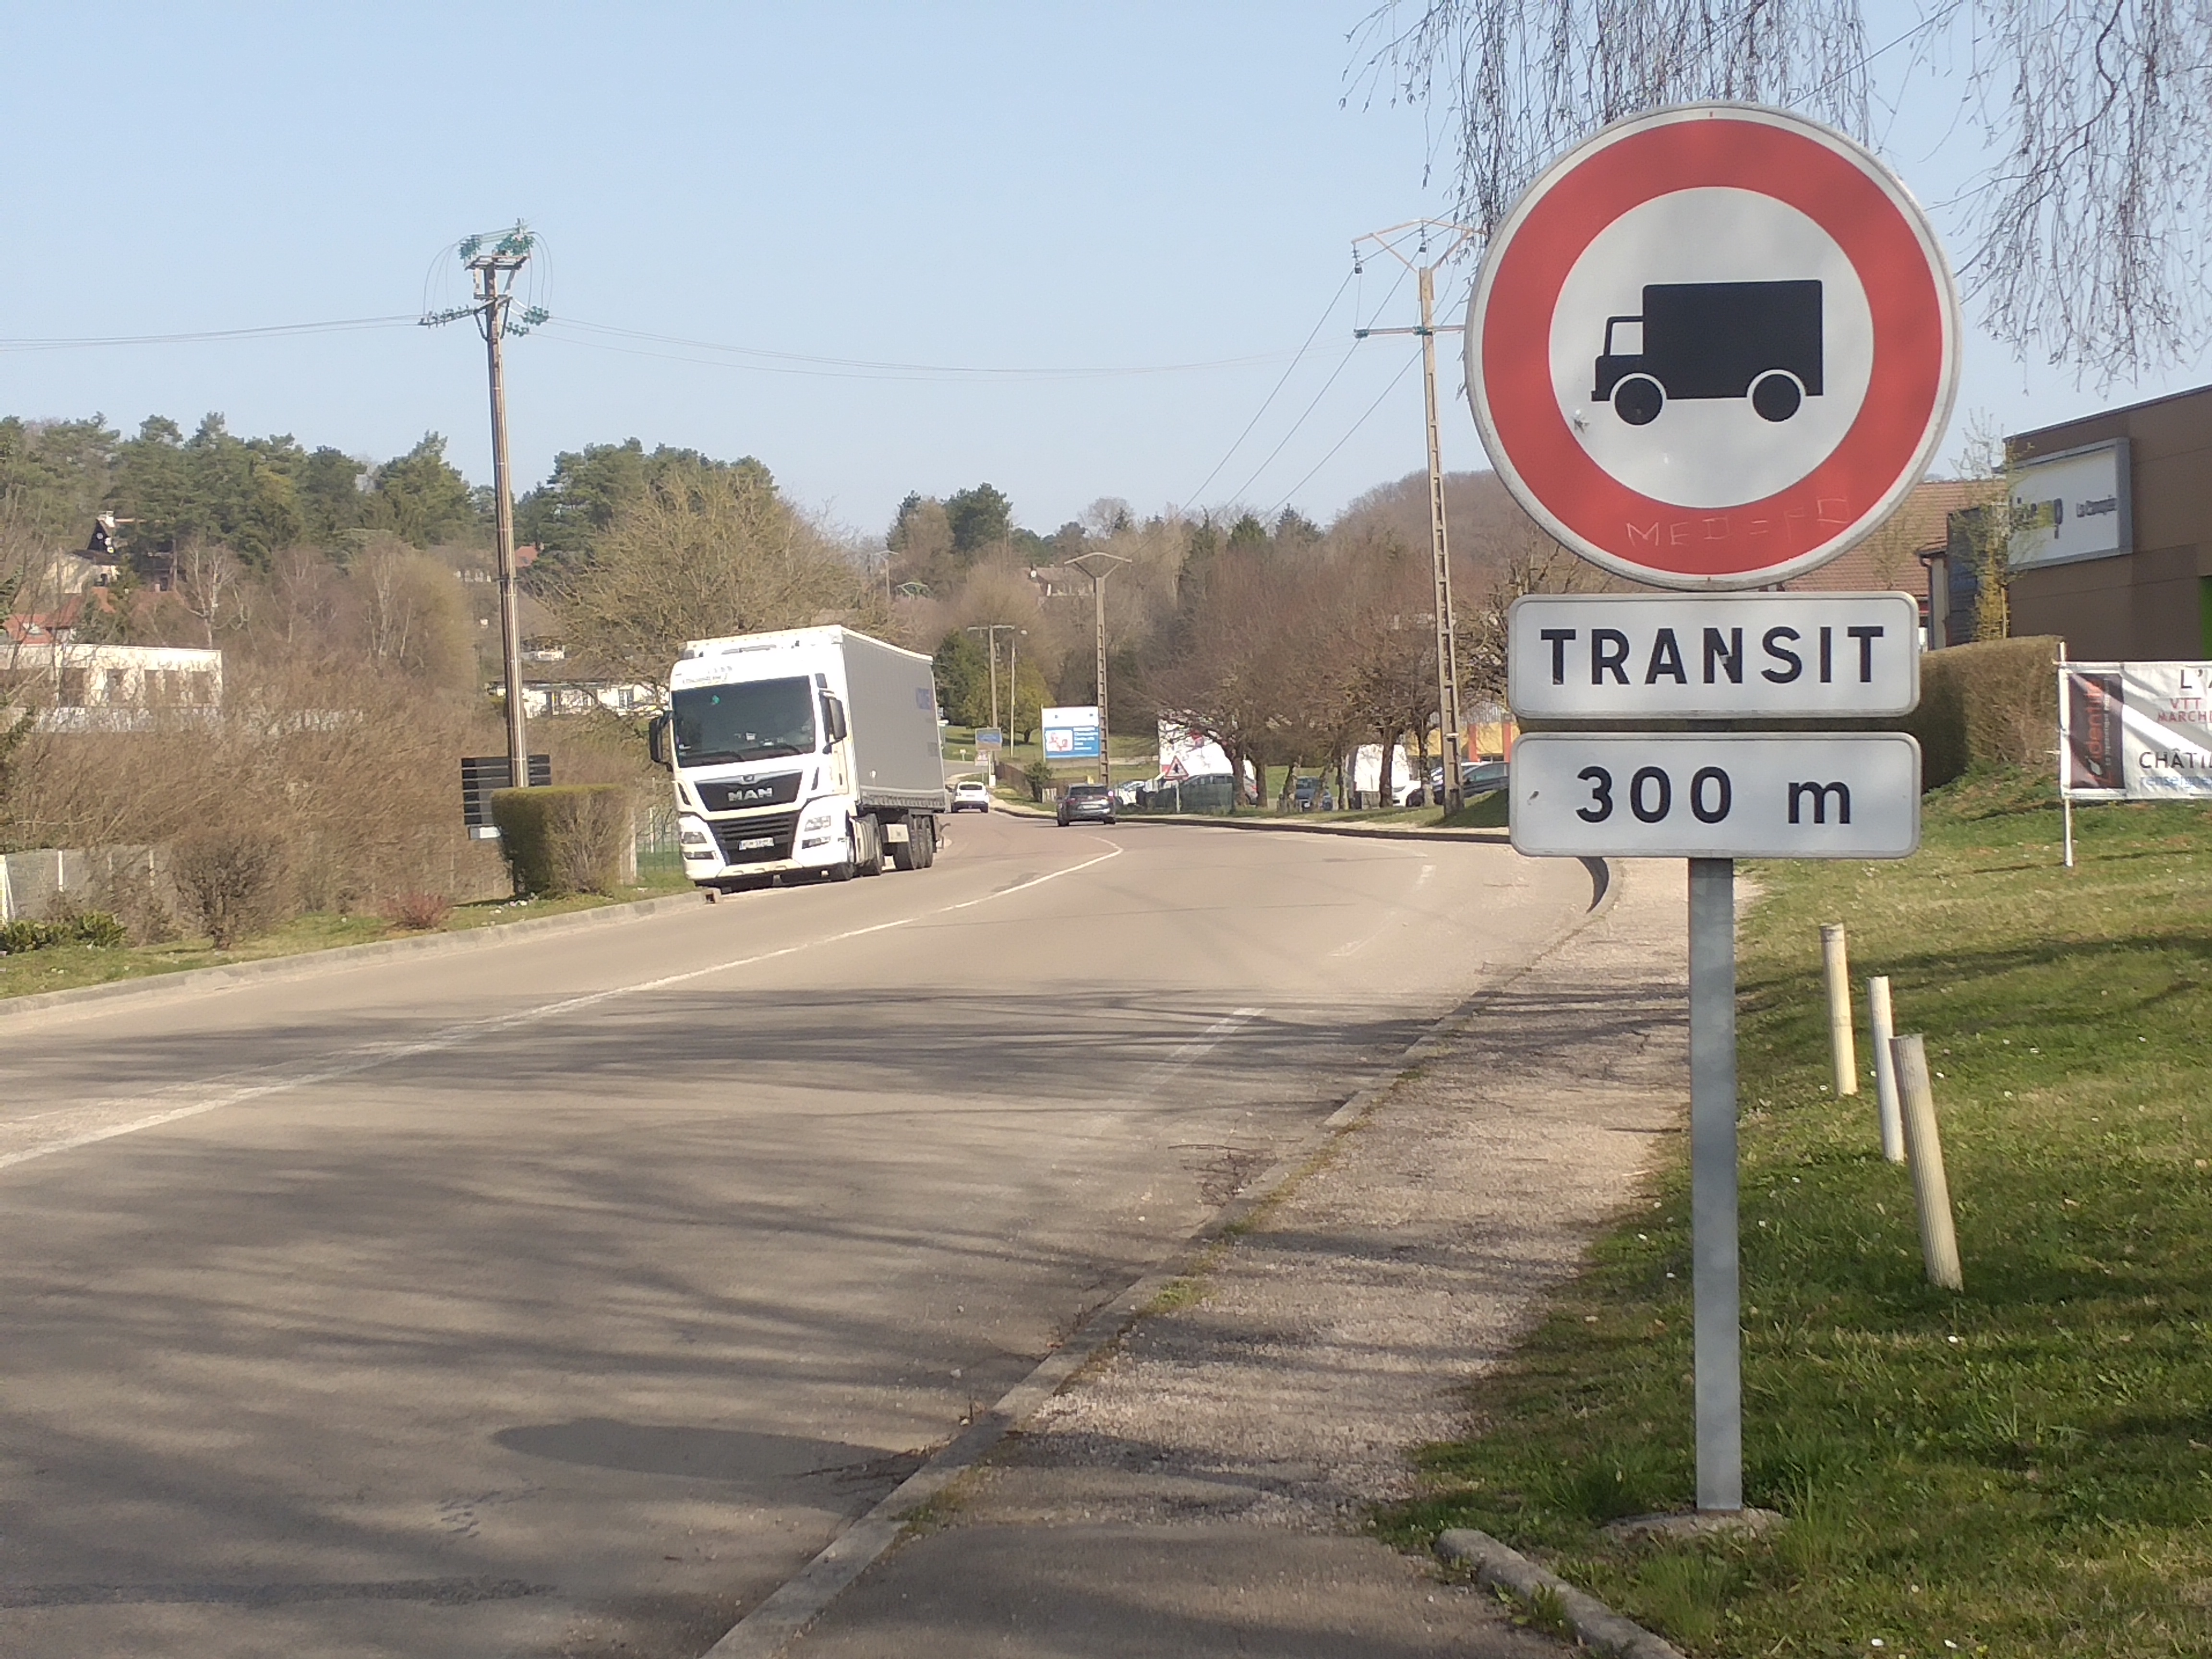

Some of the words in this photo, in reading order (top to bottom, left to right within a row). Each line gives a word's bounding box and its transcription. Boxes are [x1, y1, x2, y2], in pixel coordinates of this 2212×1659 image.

[1540, 625, 1884, 685] TRANSIT
[2180, 669, 2212, 689] L'
[2170, 697, 2201, 709] VTT
[727, 787, 773, 801] MAN
[1575, 765, 1732, 825] 300
[1787, 780, 1851, 825] m
